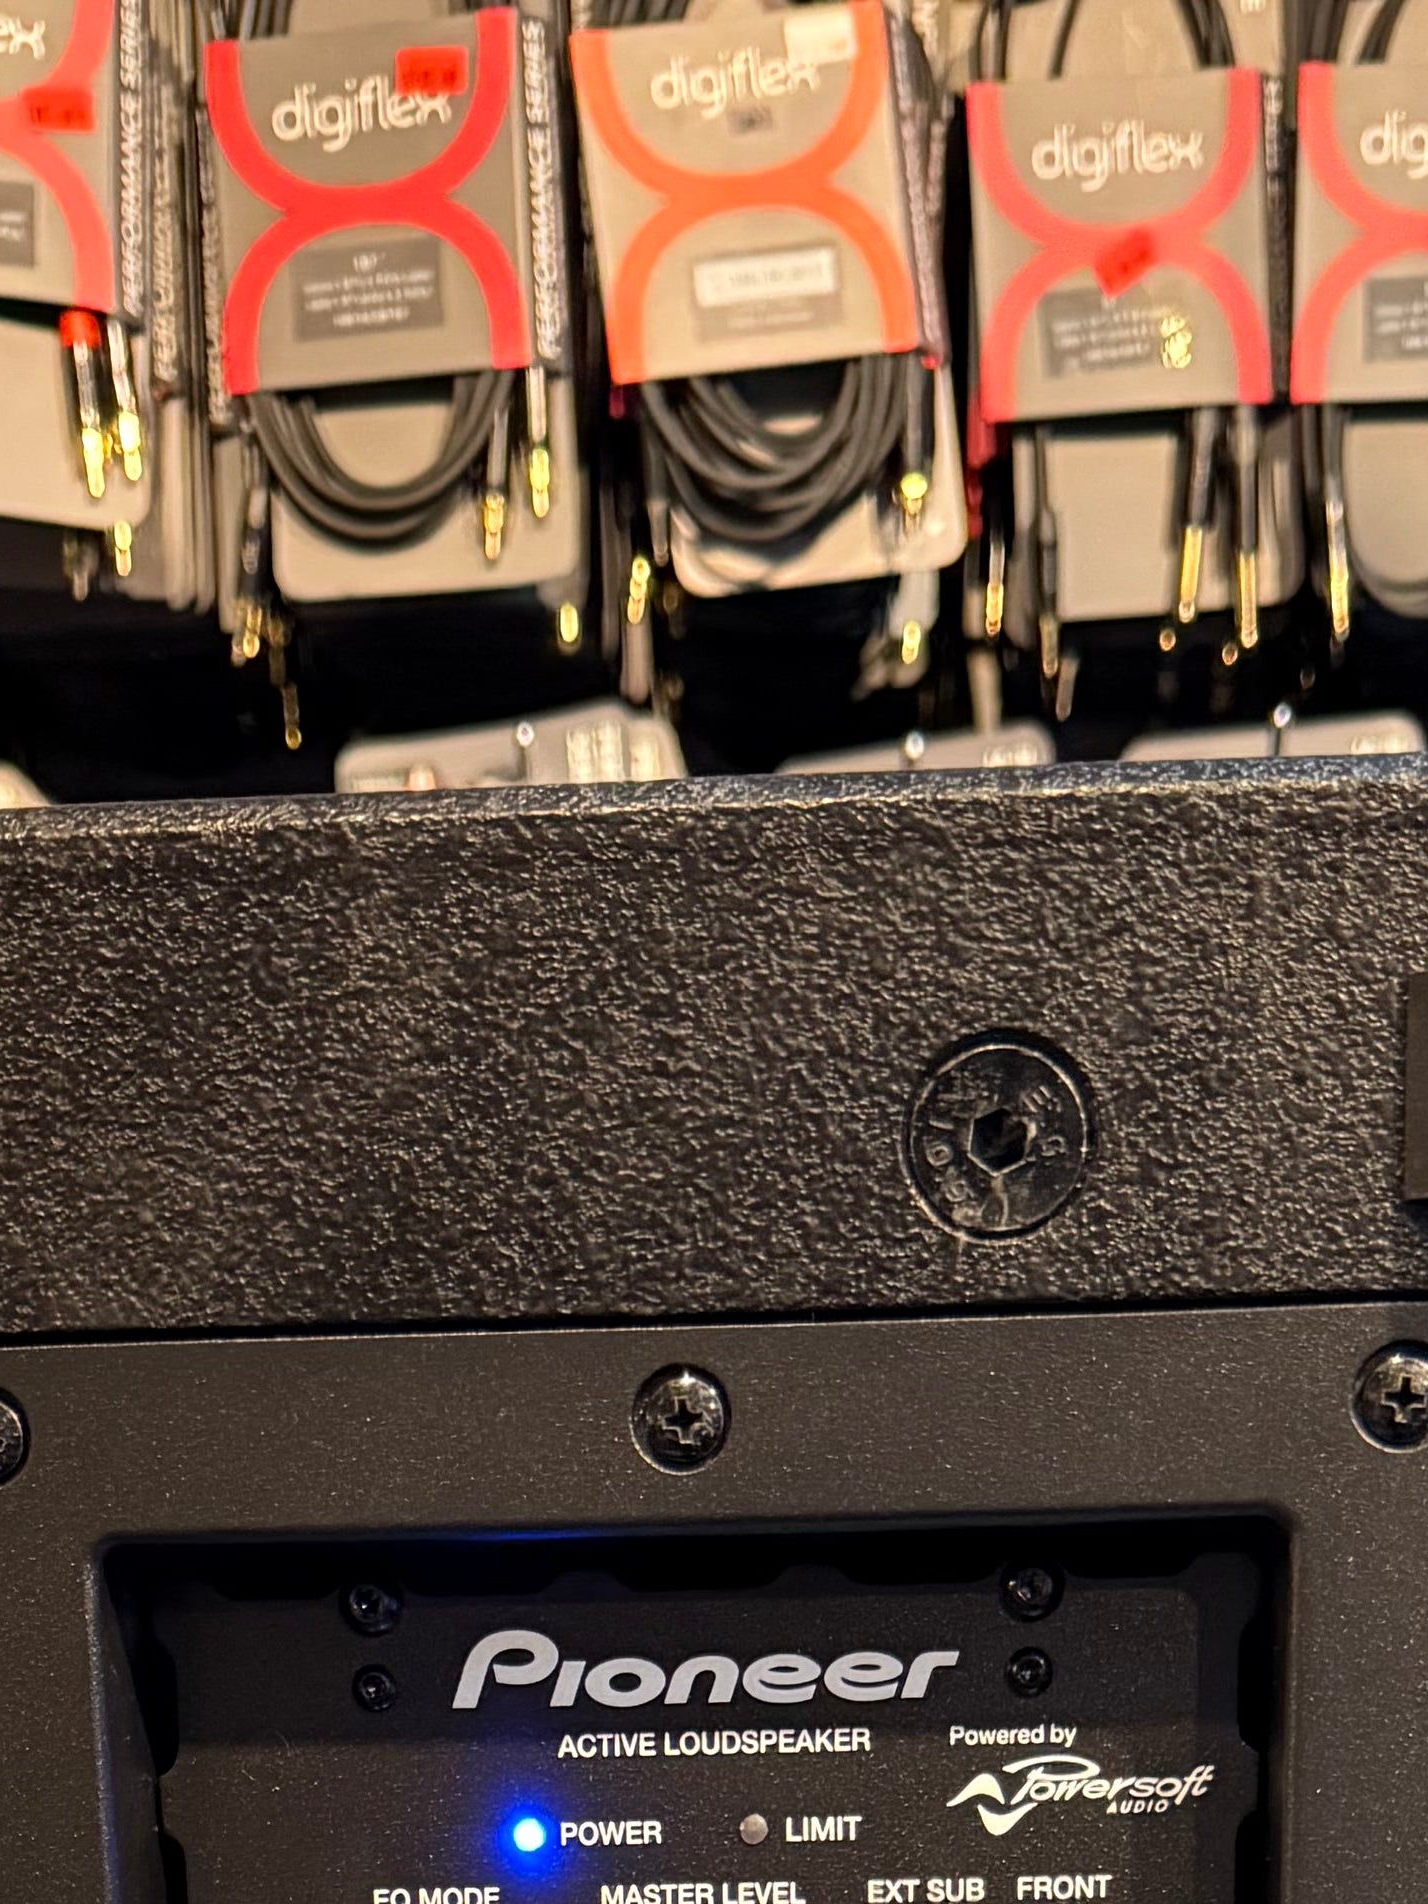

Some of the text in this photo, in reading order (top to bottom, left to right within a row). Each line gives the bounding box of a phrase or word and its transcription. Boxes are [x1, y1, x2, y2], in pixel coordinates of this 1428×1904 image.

[650, 49, 821, 120] digiflex
[1031, 120, 1205, 192] digiflex
[452, 1629, 960, 1709] Pioneer
[557, 1727, 872, 1759] ACTIVE LOUDSPEAKER
[949, 1723, 1077, 1748] Powered by
[1002, 1753, 1215, 1806] Powersoft
[1105, 1795, 1170, 1815] AUDIO
[560, 1820, 663, 1847] POWER
[785, 1815, 863, 1843] LIMIT
[867, 1876, 986, 1904] EXT SUB
[1016, 1873, 1114, 1901] FRONT
